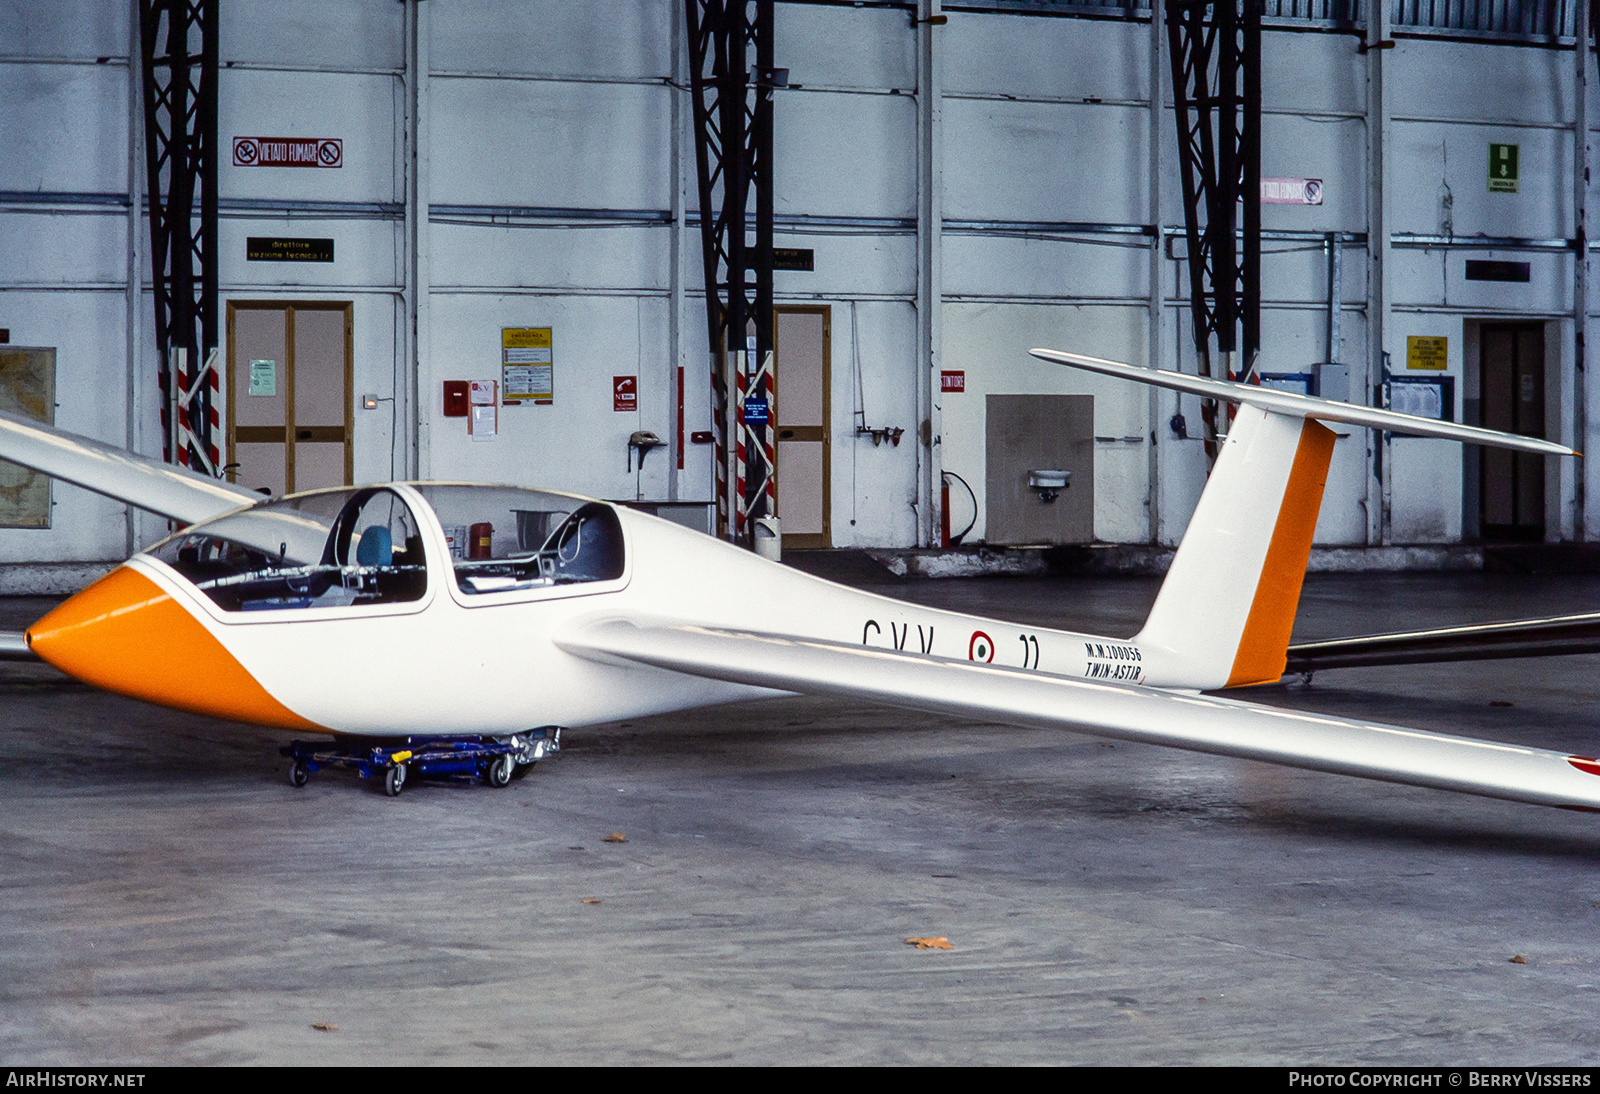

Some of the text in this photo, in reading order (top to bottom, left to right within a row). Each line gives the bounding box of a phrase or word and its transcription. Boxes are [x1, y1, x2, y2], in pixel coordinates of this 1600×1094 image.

[260, 142, 318, 162] VIETATO FUMARE
[271, 241, 310, 249] direttore
[249, 251, 283, 259] sezione
[285, 251, 318, 259] tecnica
[941, 375, 964, 388] TINTORE
[1084, 642, 1142, 662] M.M.100056
[1084, 662, 1142, 681] TWIN-ASTIR
